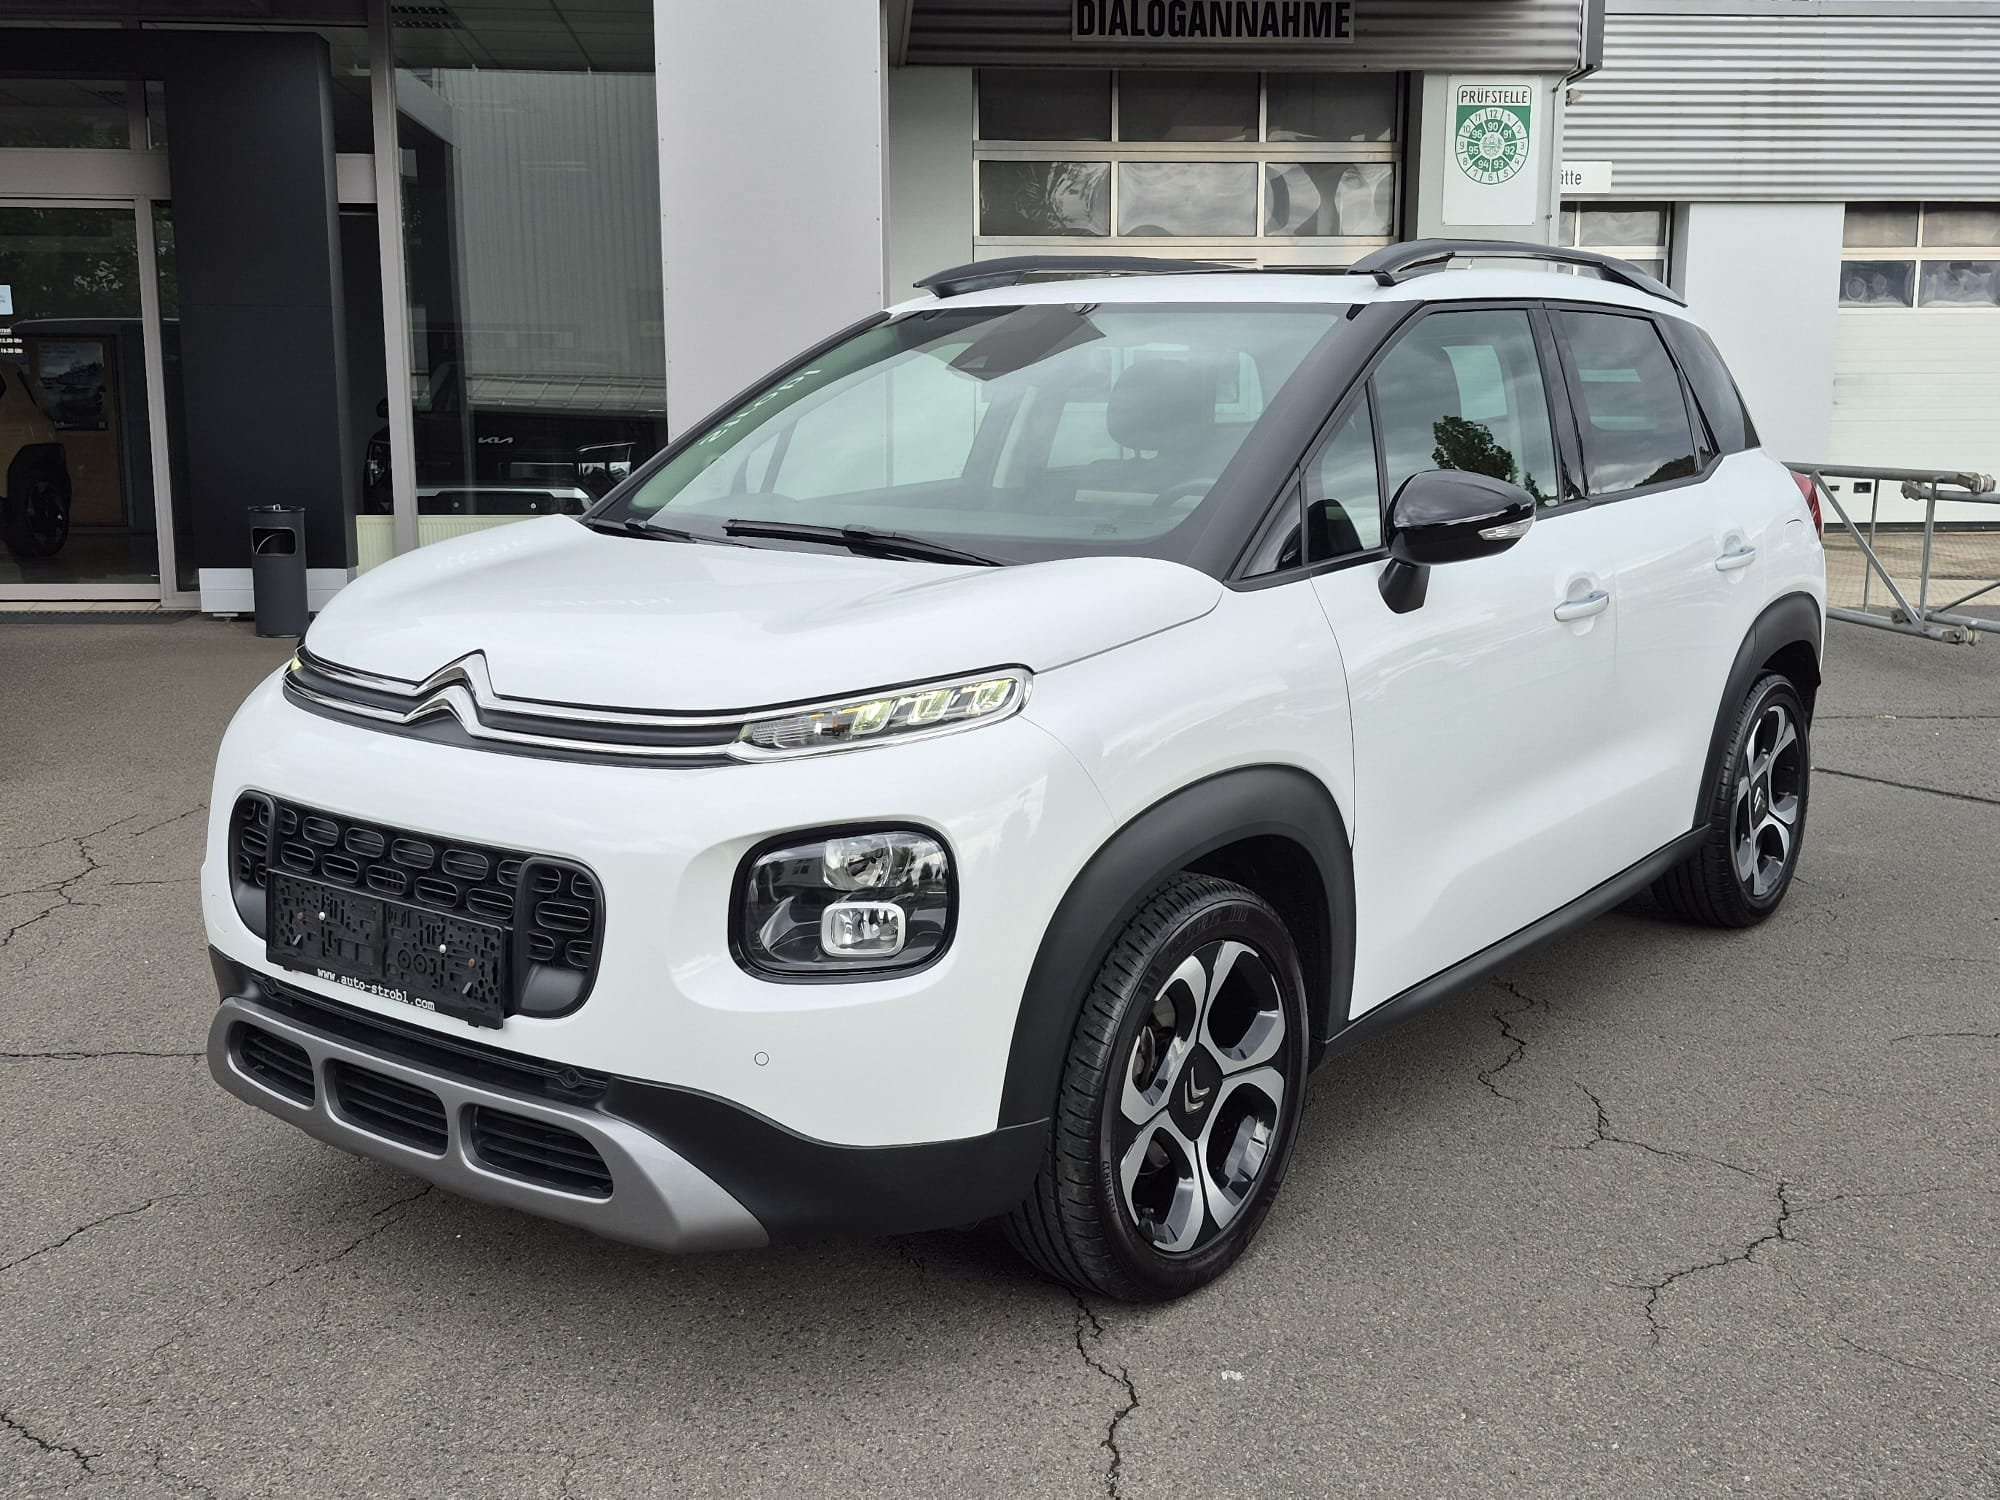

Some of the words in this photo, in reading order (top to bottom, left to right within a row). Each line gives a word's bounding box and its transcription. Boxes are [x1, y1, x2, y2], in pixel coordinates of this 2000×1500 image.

[1076, 0, 1351, 38] DIALOGANNAHME
[1461, 87, 1528, 104] PRÜFSTELLE
[1489, 109, 1498, 119] 12
[1487, 121, 1499, 131] 90
[1472, 130, 1482, 139] 96
[1503, 130, 1512, 139] 91
[1460, 141, 1465, 150] 9
[1468, 146, 1479, 155] 95
[1504, 146, 1515, 155] 92
[1478, 160, 1488, 169] 94
[1493, 160, 1504, 169] 93
[1488, 172, 1493, 181] 6
[316, 968, 436, 1012] www.auto-strobl.com
